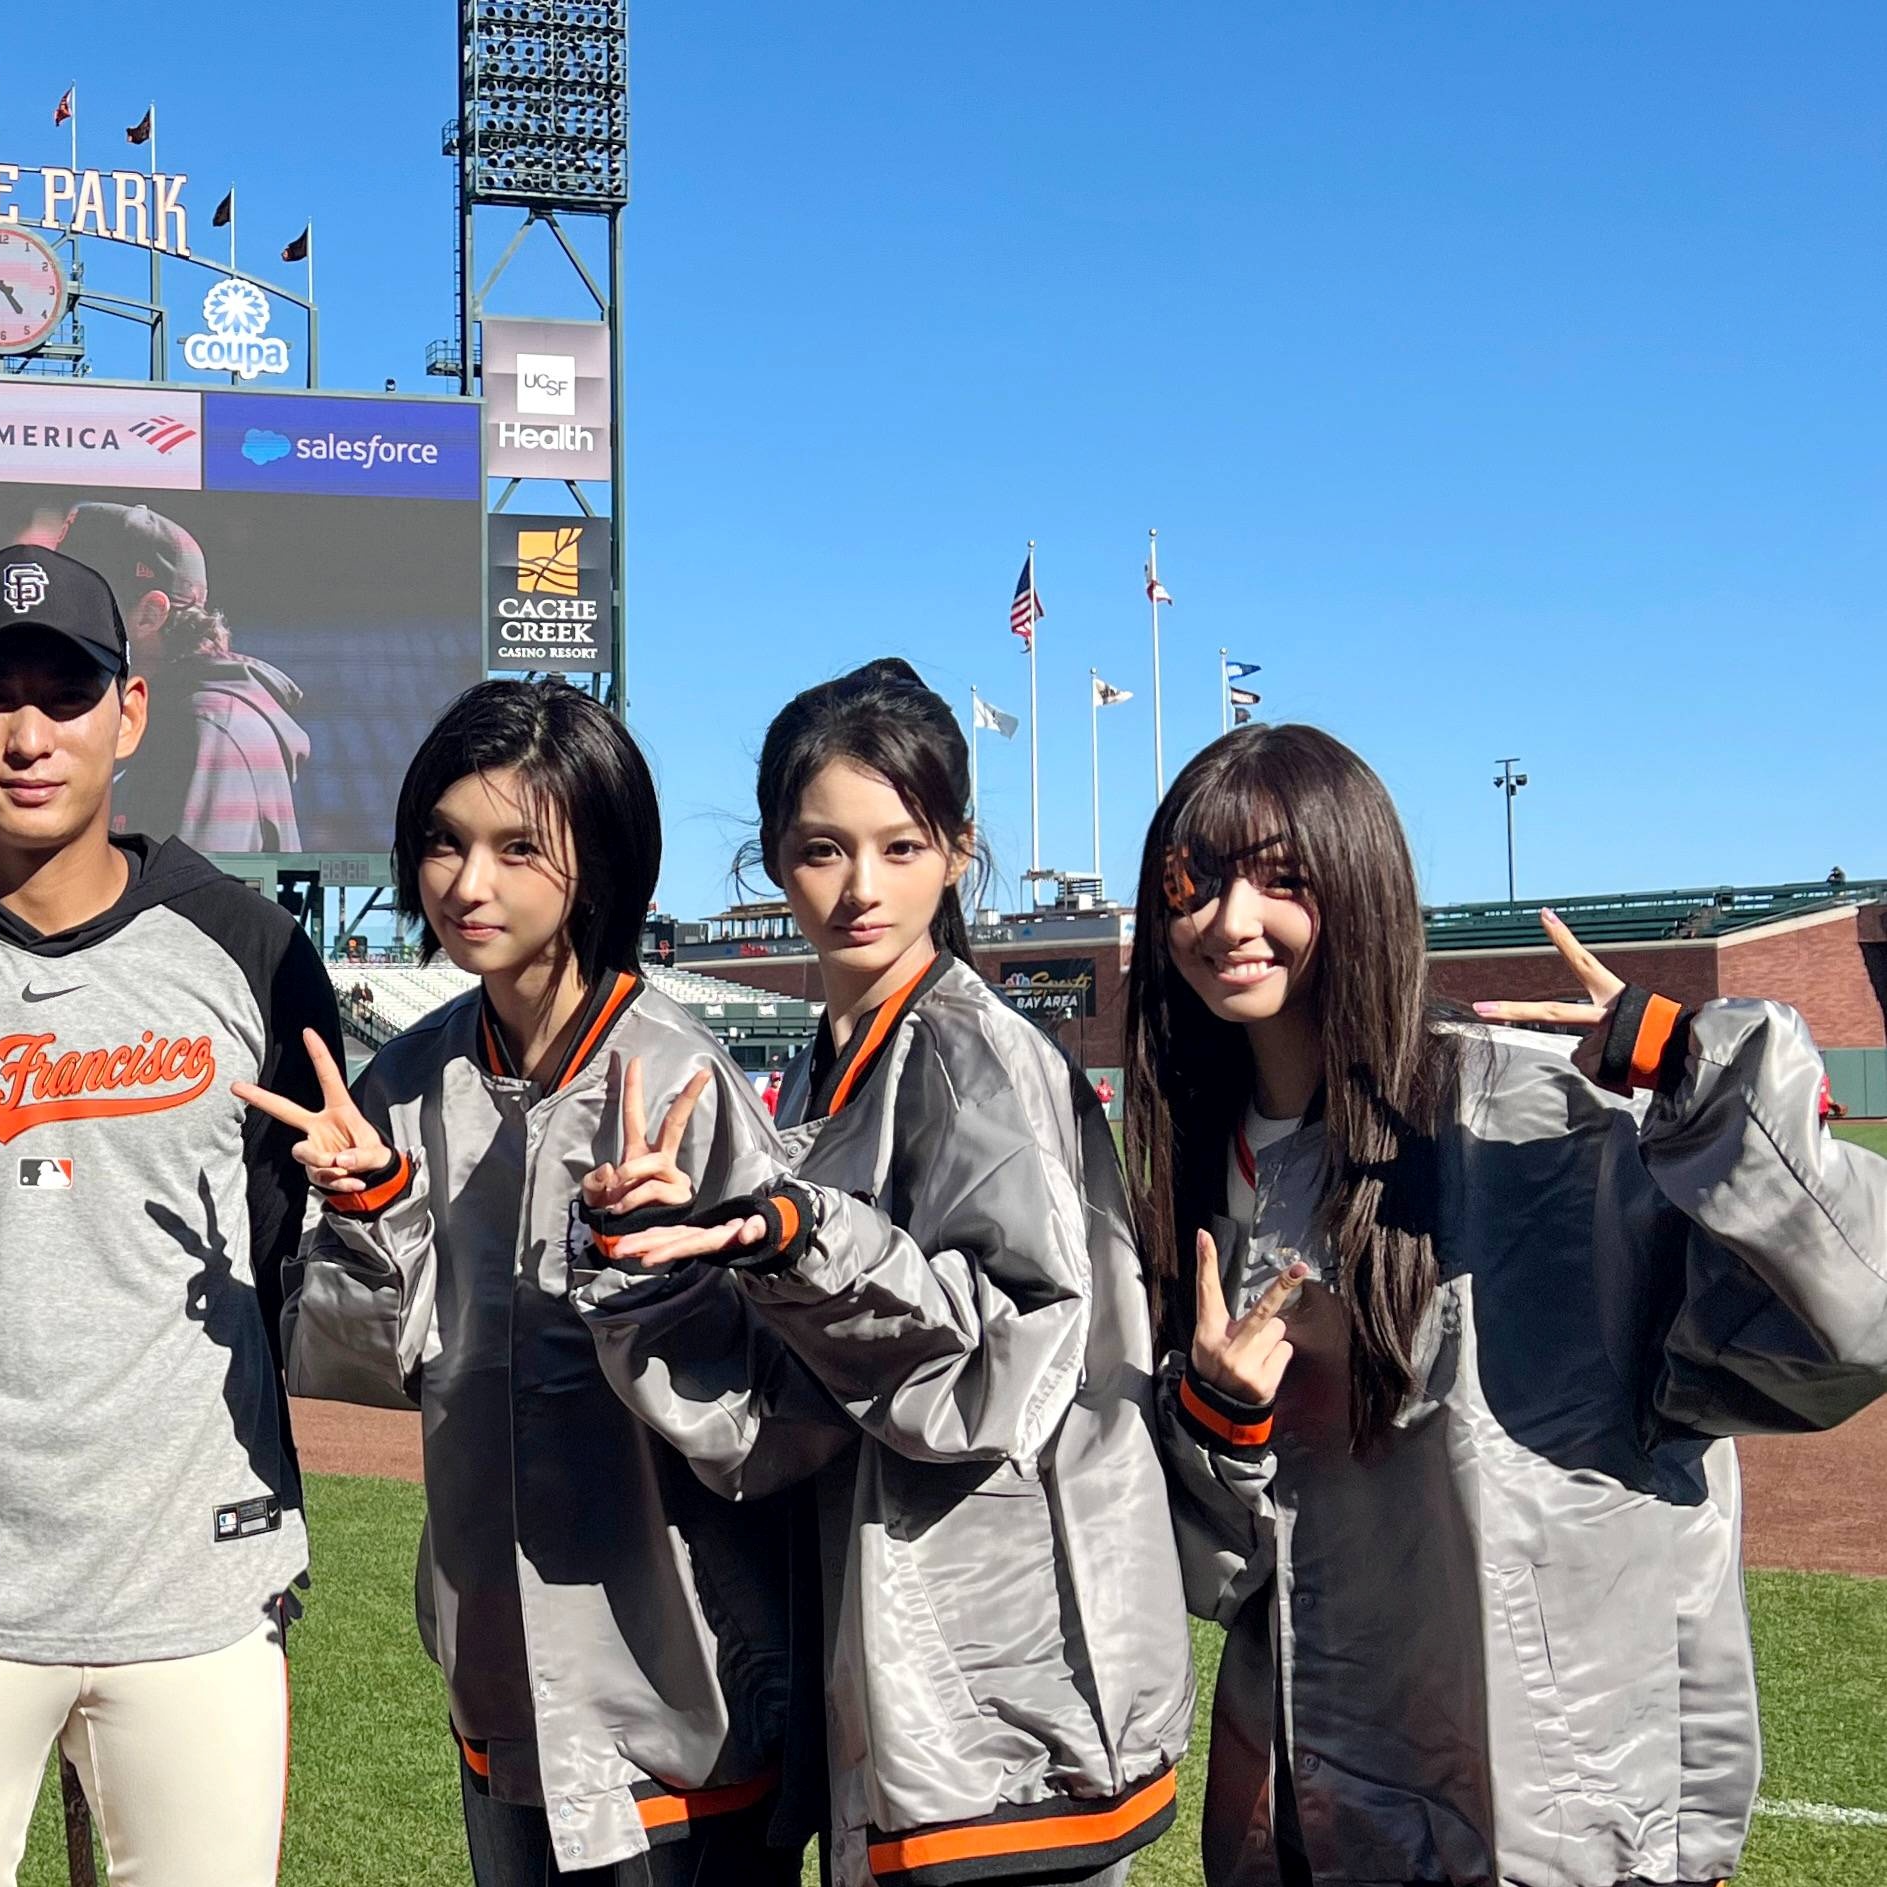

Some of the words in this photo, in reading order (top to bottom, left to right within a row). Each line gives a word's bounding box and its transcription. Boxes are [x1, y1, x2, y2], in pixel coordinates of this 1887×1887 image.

[41, 166, 192, 258] PARK
[191, 334, 286, 373] coupa
[524, 373, 568, 397] UCSF
[498, 421, 594, 451] Health
[296, 432, 438, 469] salesforce
[498, 598, 598, 620] CACHE
[500, 622, 594, 643] CREEK
[498, 646, 546, 659] CASINO
[549, 647, 598, 660] RESORT
[1016, 995, 1041, 1010] BAY
[1043, 994, 1078, 1009] AREA
